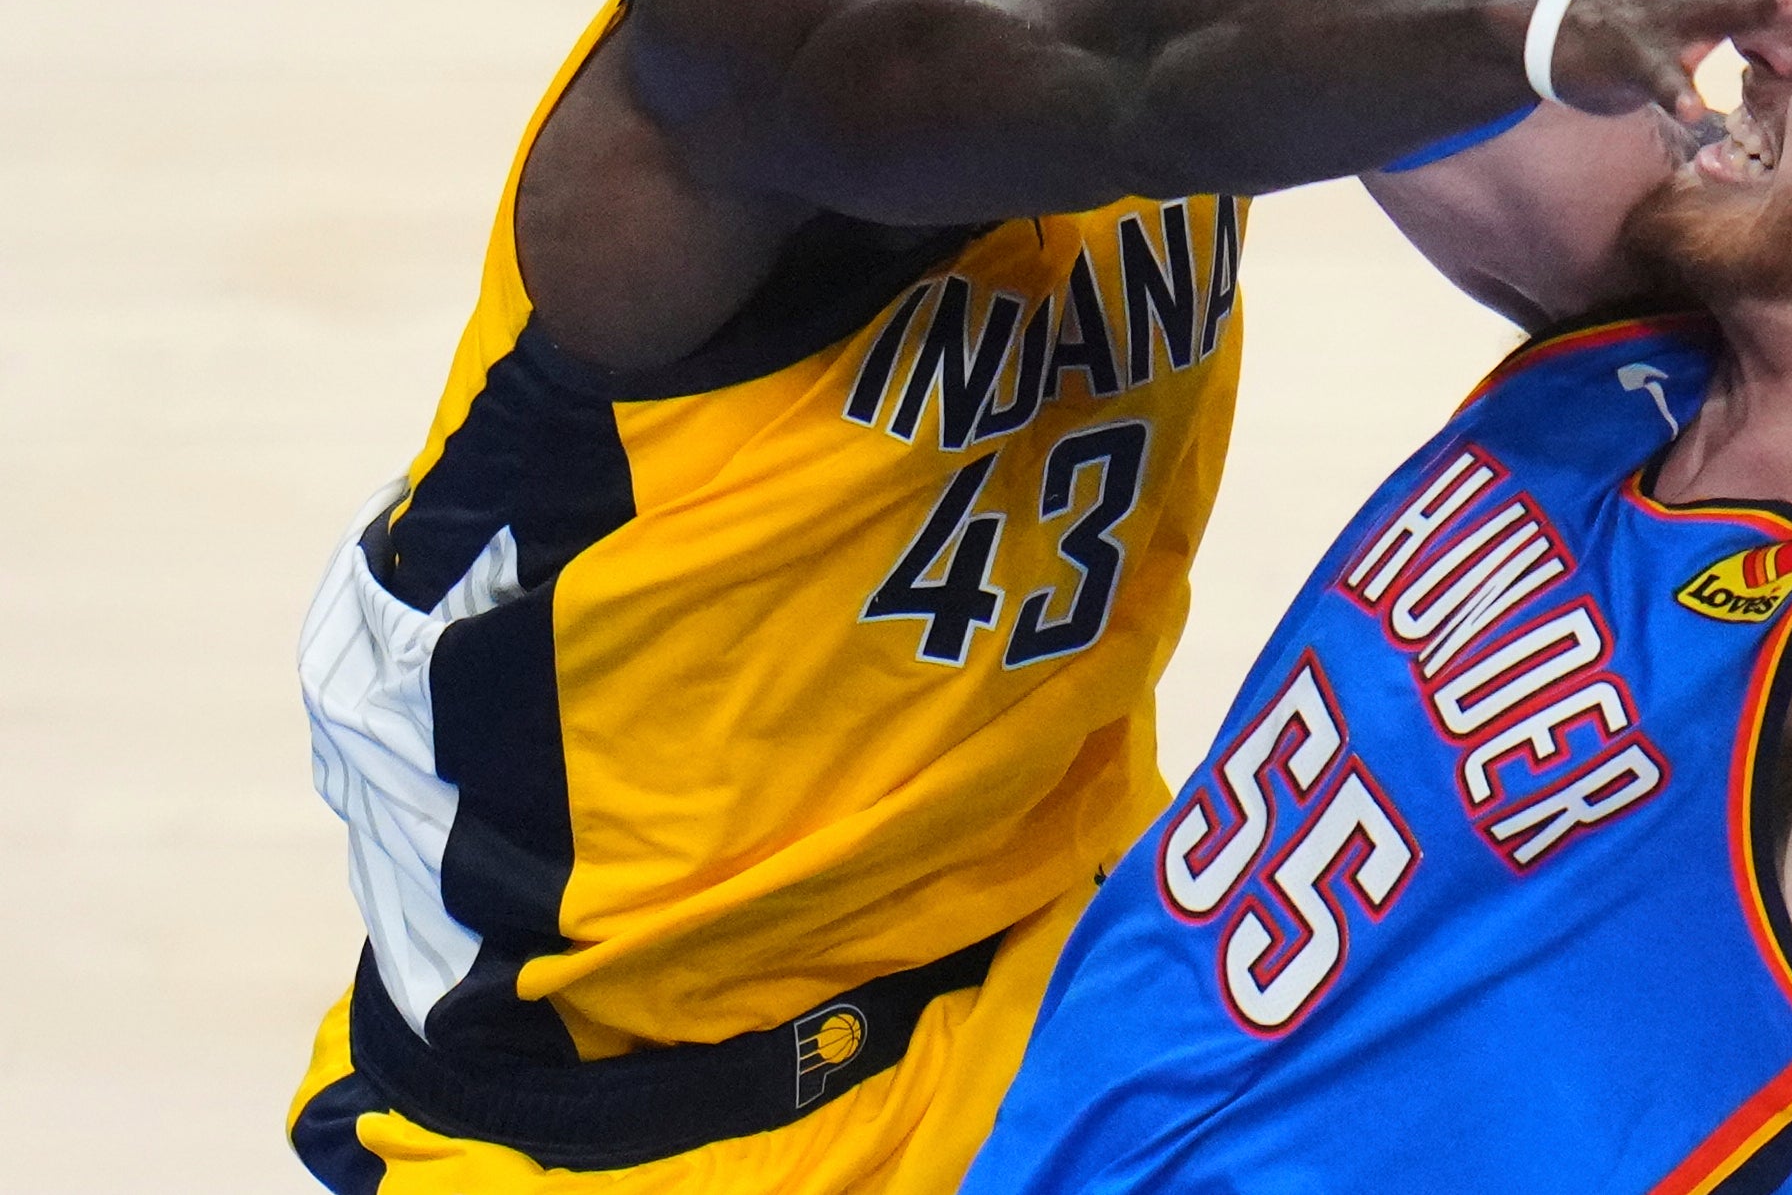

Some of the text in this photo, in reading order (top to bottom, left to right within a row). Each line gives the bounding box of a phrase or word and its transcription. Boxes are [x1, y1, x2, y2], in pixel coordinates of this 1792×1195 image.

[841, 193, 1240, 453] INDANA
[858, 419, 1150, 670] 43
[1333, 444, 1671, 876] HUNDER
[1157, 646, 1424, 1041] 55
